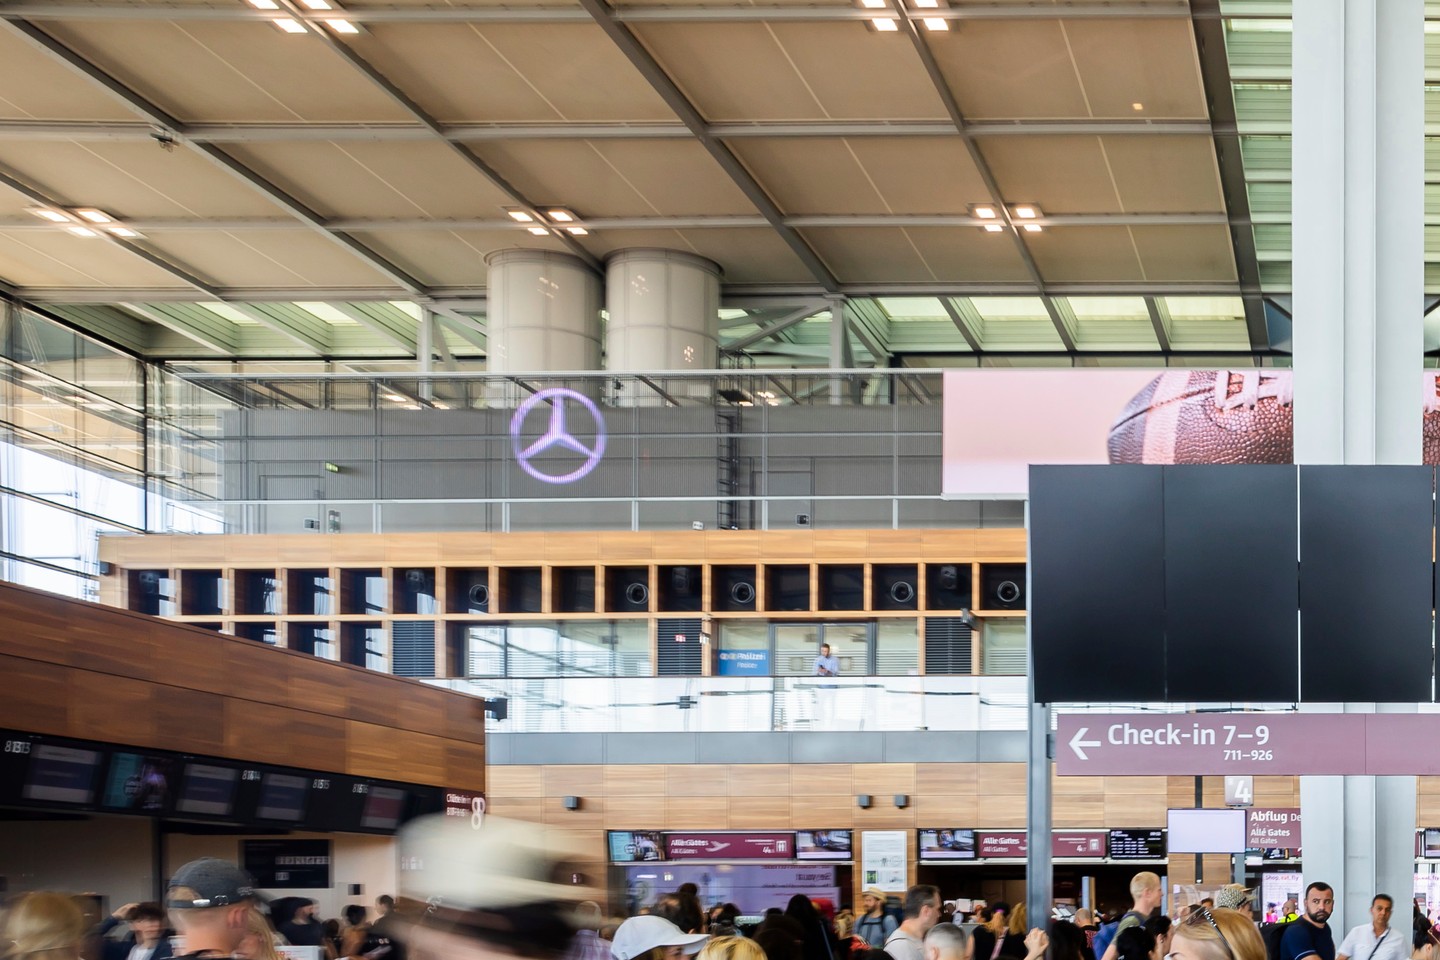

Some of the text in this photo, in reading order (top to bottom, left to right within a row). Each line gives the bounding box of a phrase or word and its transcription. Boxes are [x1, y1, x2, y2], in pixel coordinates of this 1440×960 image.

[1107, 723, 1270, 746] Check-in 7–9
[1223, 750, 1273, 761] 711–926
[1234, 779, 1252, 803] 4
[471, 797, 486, 830] 8
[1250, 811, 1288, 823] Abflug
[1250, 828, 1290, 837] Alle Gates
[983, 837, 1020, 845] Alle Gates
